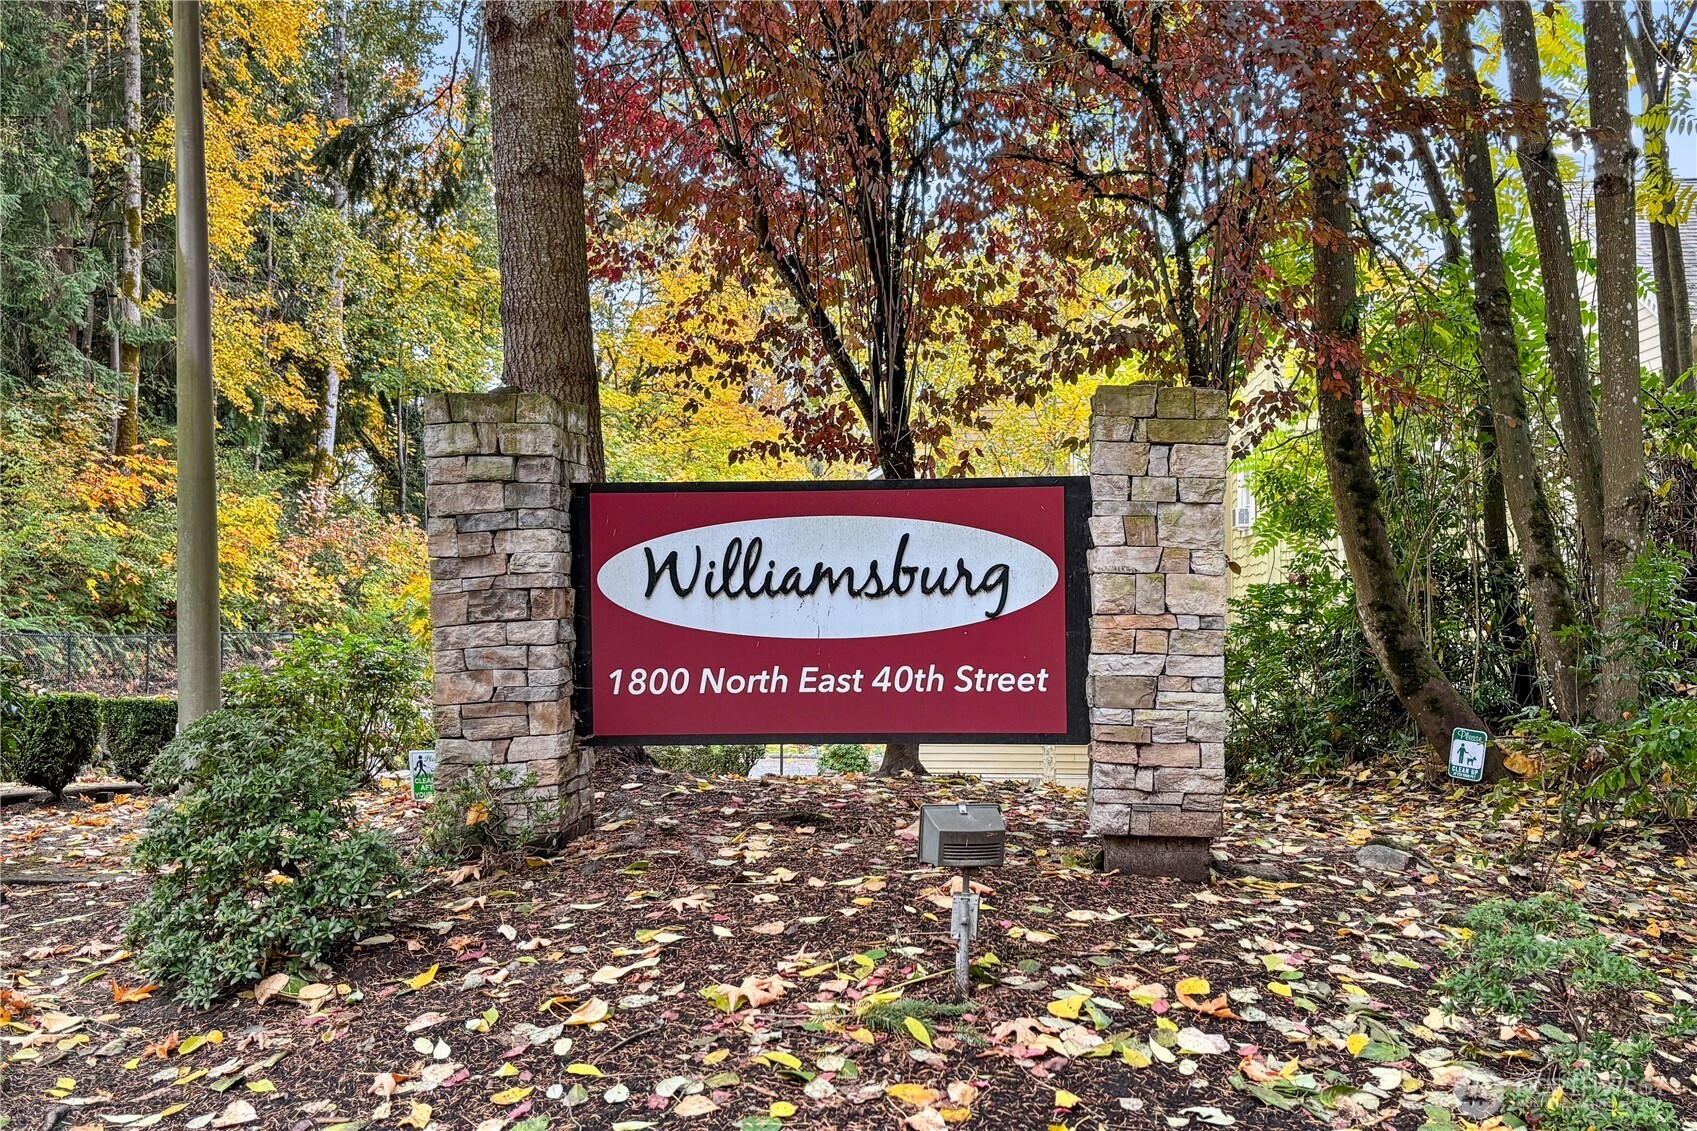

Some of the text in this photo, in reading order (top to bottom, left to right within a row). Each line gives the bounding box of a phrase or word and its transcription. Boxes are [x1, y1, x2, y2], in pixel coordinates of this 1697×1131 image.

[644, 532, 1010, 619] Williamsburg
[608, 664, 1050, 695] 1800 North East 40th Street
[1452, 766, 1470, 774] CLEAN
